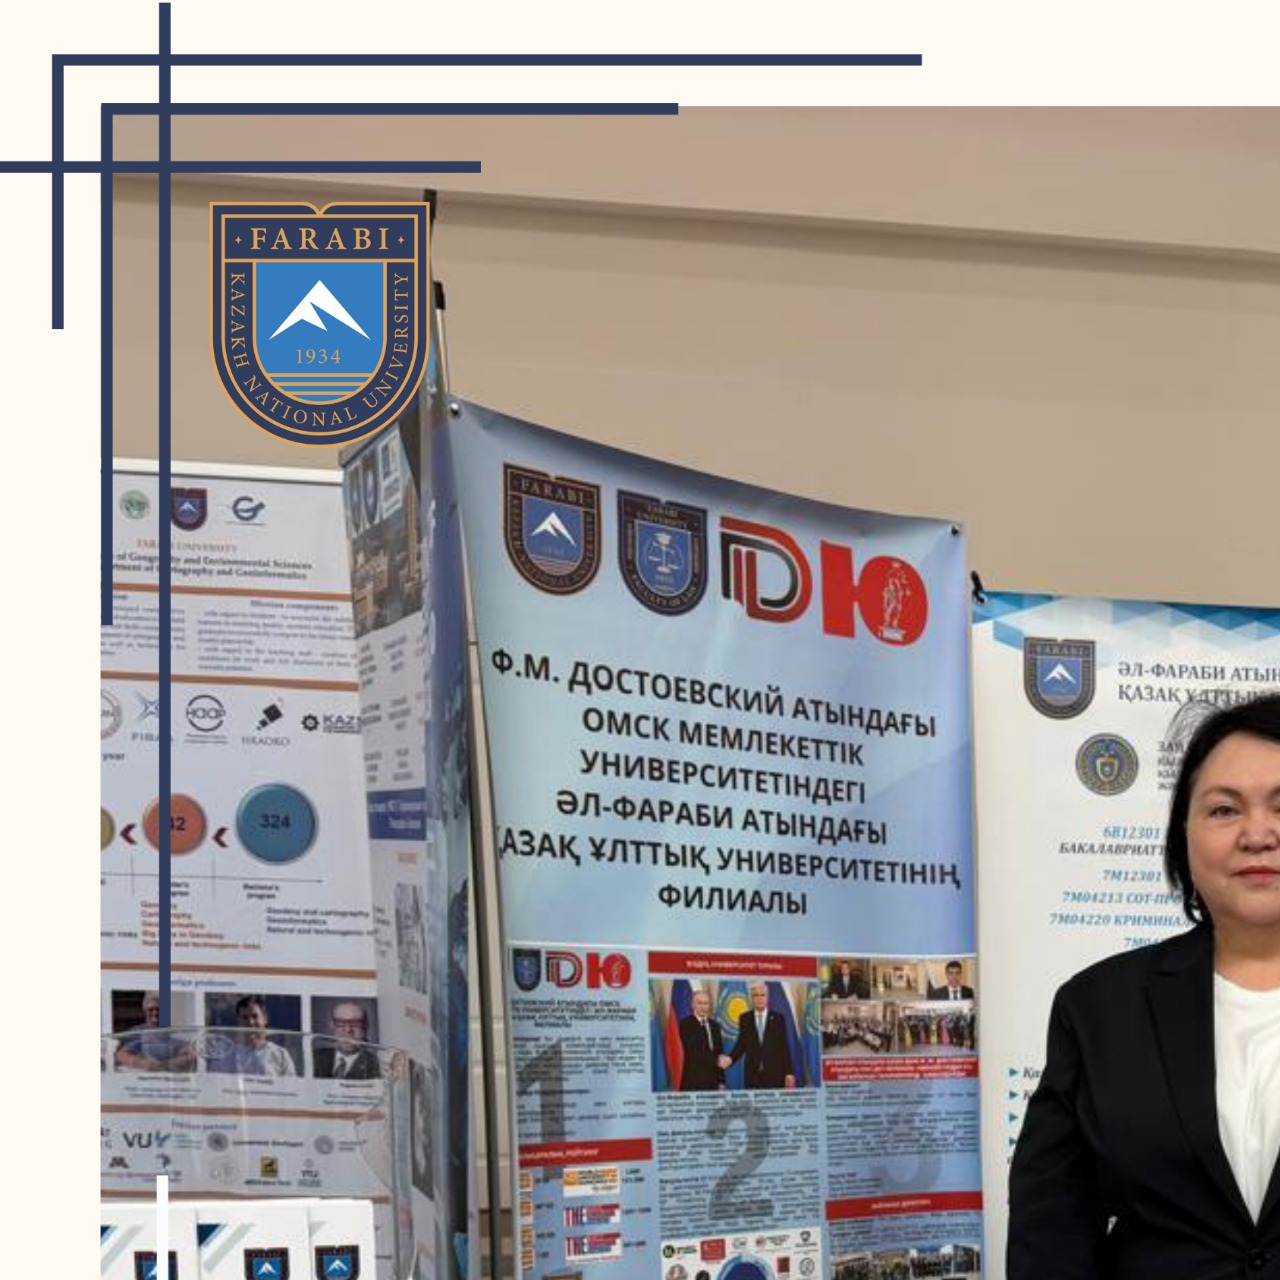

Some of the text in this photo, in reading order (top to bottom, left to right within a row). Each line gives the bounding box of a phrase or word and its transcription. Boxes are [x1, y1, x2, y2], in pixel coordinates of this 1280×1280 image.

[492, 648, 936, 737] Ф.М. ДОСТОЕВСКИЙ АТЫНДАҒЫ
[1118, 662, 1226, 682] ӘЛ-ФАРАБИ
[1118, 684, 1185, 705] ҚАЗАҚ
[583, 708, 863, 766] ОМСК МЕМЛЕКЕТТІК
[580, 749, 866, 803] УНИВЕРСИТЕТІНДЕГІ
[261, 815, 290, 828] 324
[556, 791, 886, 845] ӘЛ-ФАРАБИ АТЫНДАҒЫ
[589, 839, 709, 875] ҰЛТТЫҚ
[717, 848, 960, 888] УНИВЕРСИТЕТІНІҢ
[659, 886, 807, 914] ФИЛИАЛЫ
